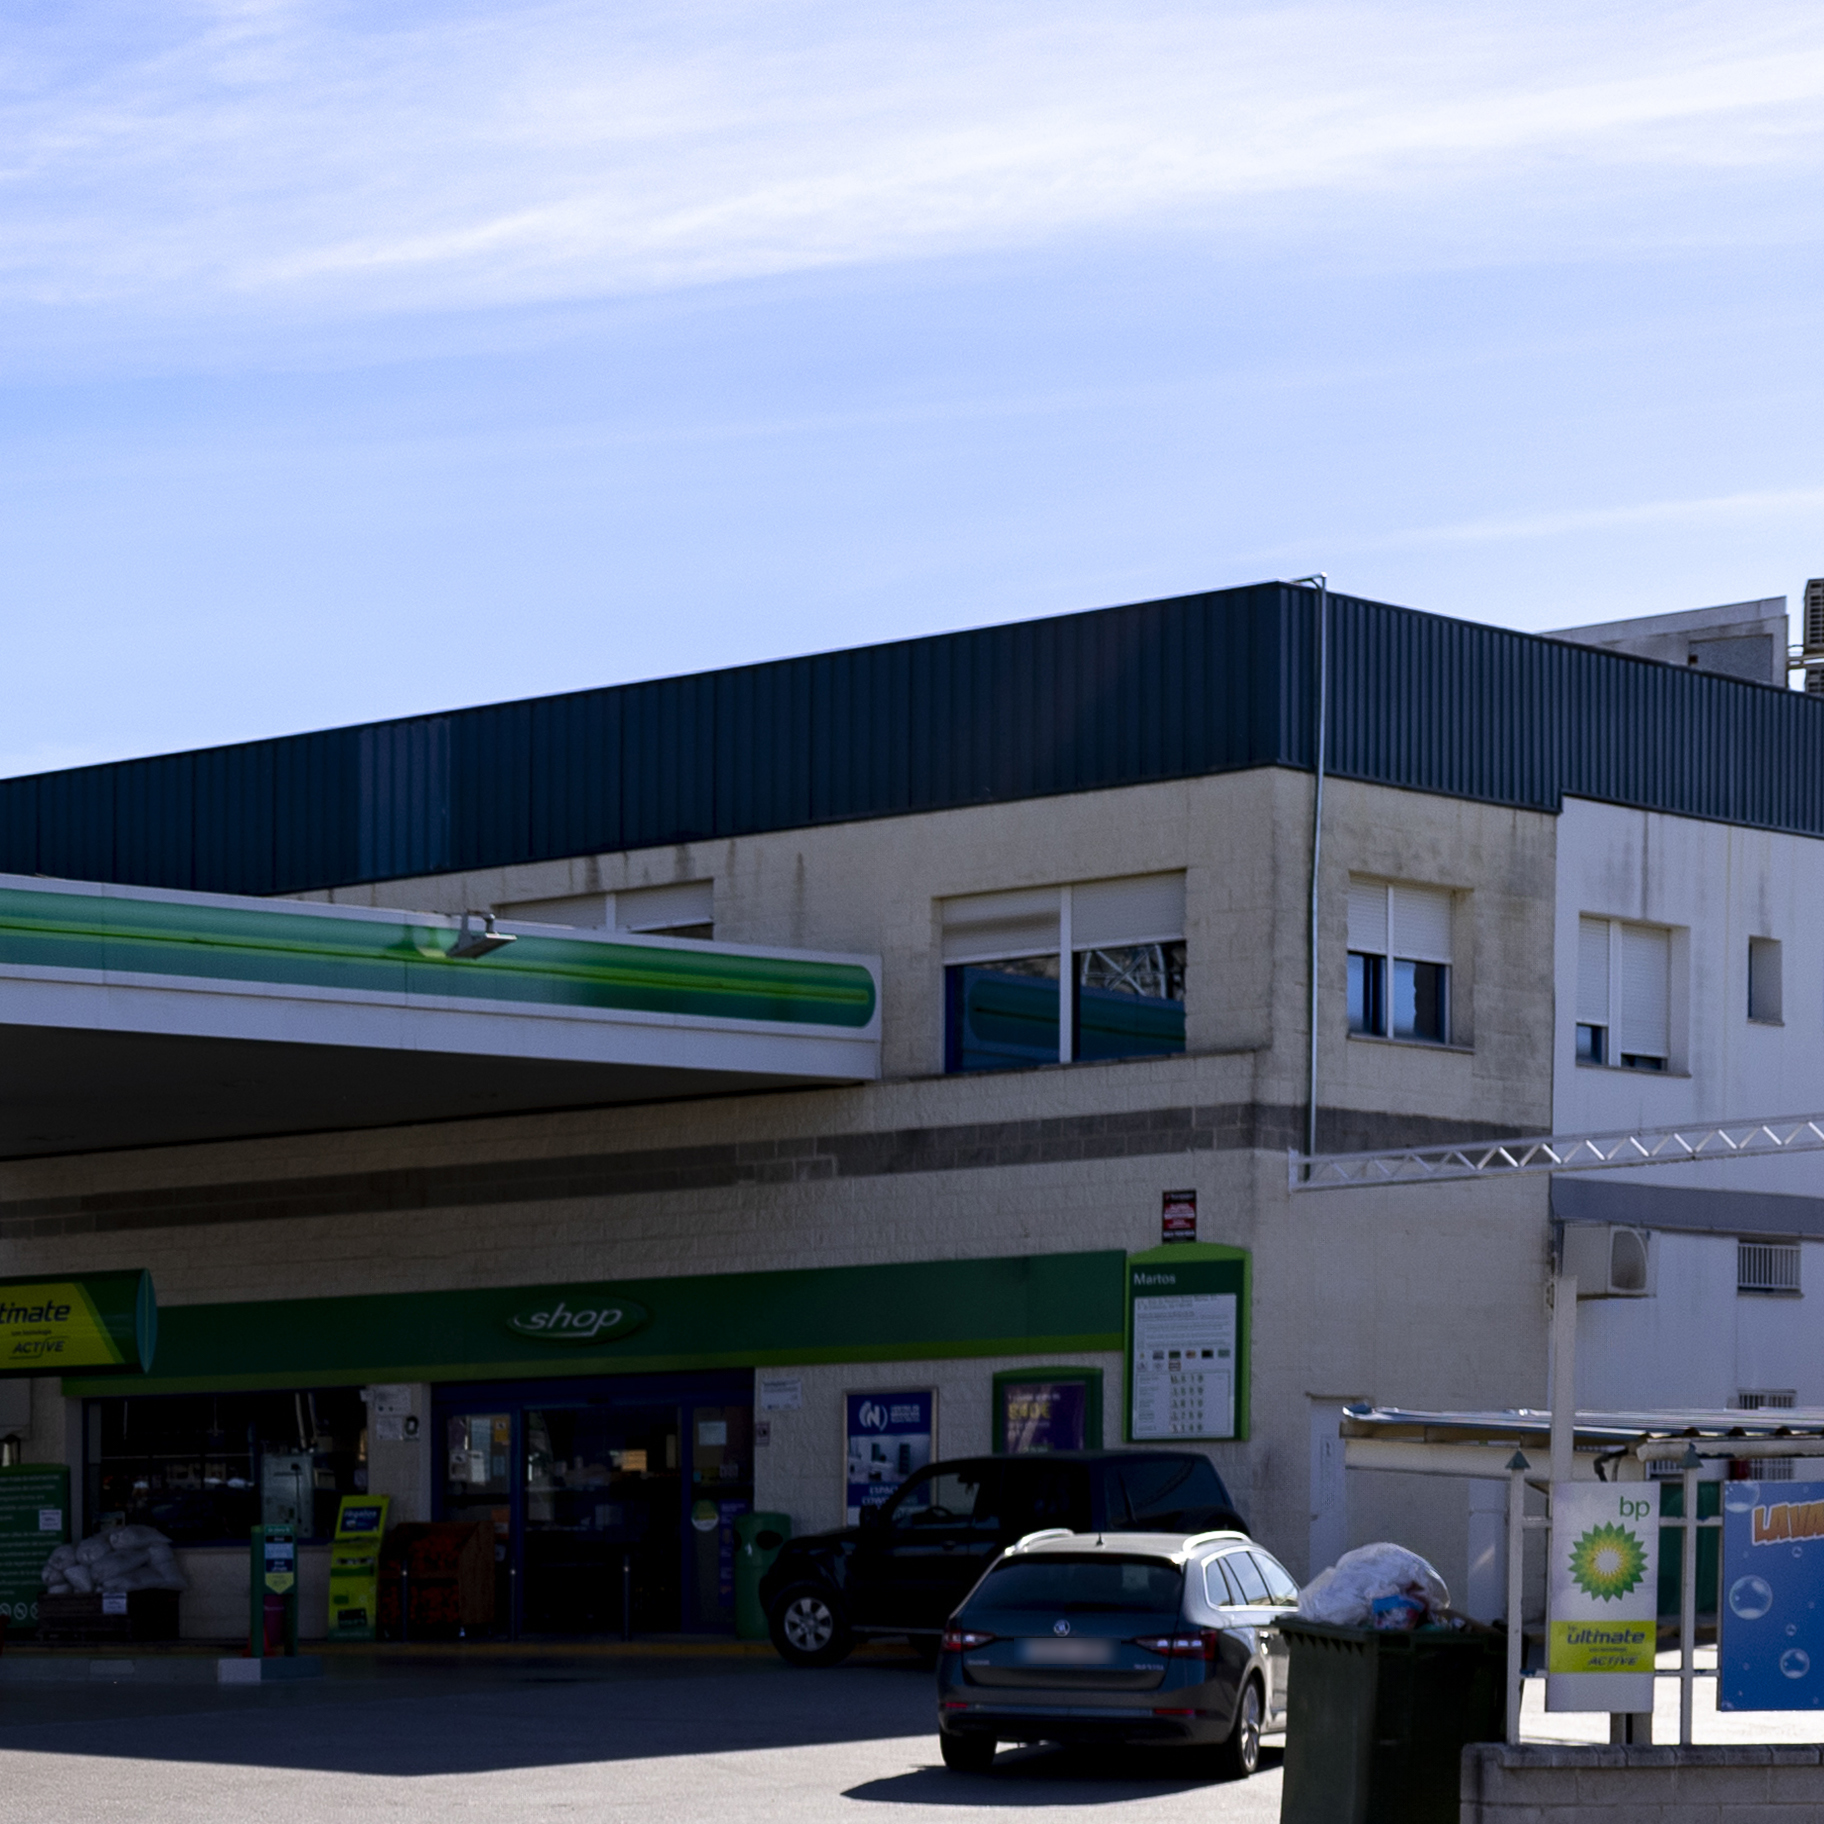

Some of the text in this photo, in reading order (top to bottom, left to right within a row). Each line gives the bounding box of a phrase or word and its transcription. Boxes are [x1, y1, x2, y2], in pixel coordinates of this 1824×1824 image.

[1133, 1272, 1176, 1286] Martos
[526, 1301, 624, 1338] shop
[13, 1339, 64, 1354] ACTIVE
[1620, 1496, 1650, 1521] bp
[1567, 1628, 1645, 1645] ultimate
[1588, 1655, 1638, 1666] ACTIVE
